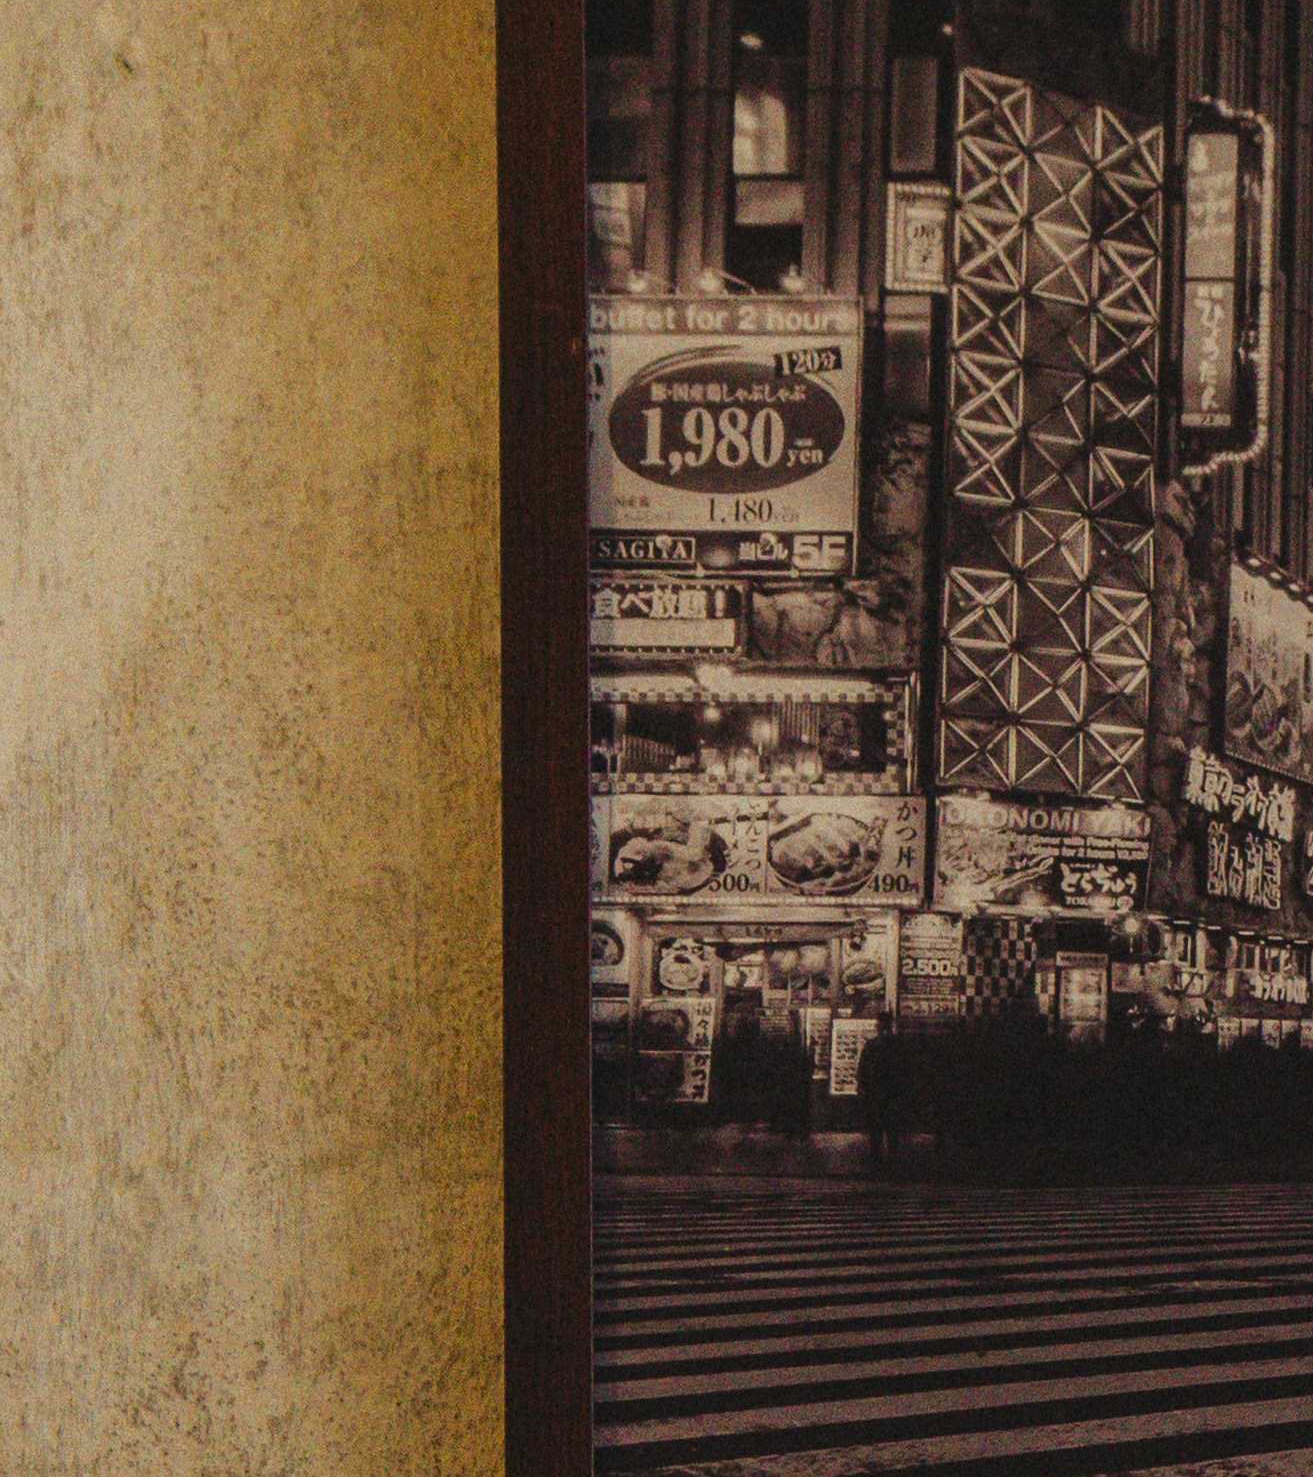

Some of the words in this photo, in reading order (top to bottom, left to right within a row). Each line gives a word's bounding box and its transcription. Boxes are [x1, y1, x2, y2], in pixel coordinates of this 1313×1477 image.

[685, 304, 728, 330] for
[738, 304, 759, 330] 2
[766, 304, 855, 330] hours
[640, 407, 785, 475] 1,980
[786, 445, 823, 467] yen
[792, 534, 846, 571] 5F
[896, 800, 920, 869] かつ丼
